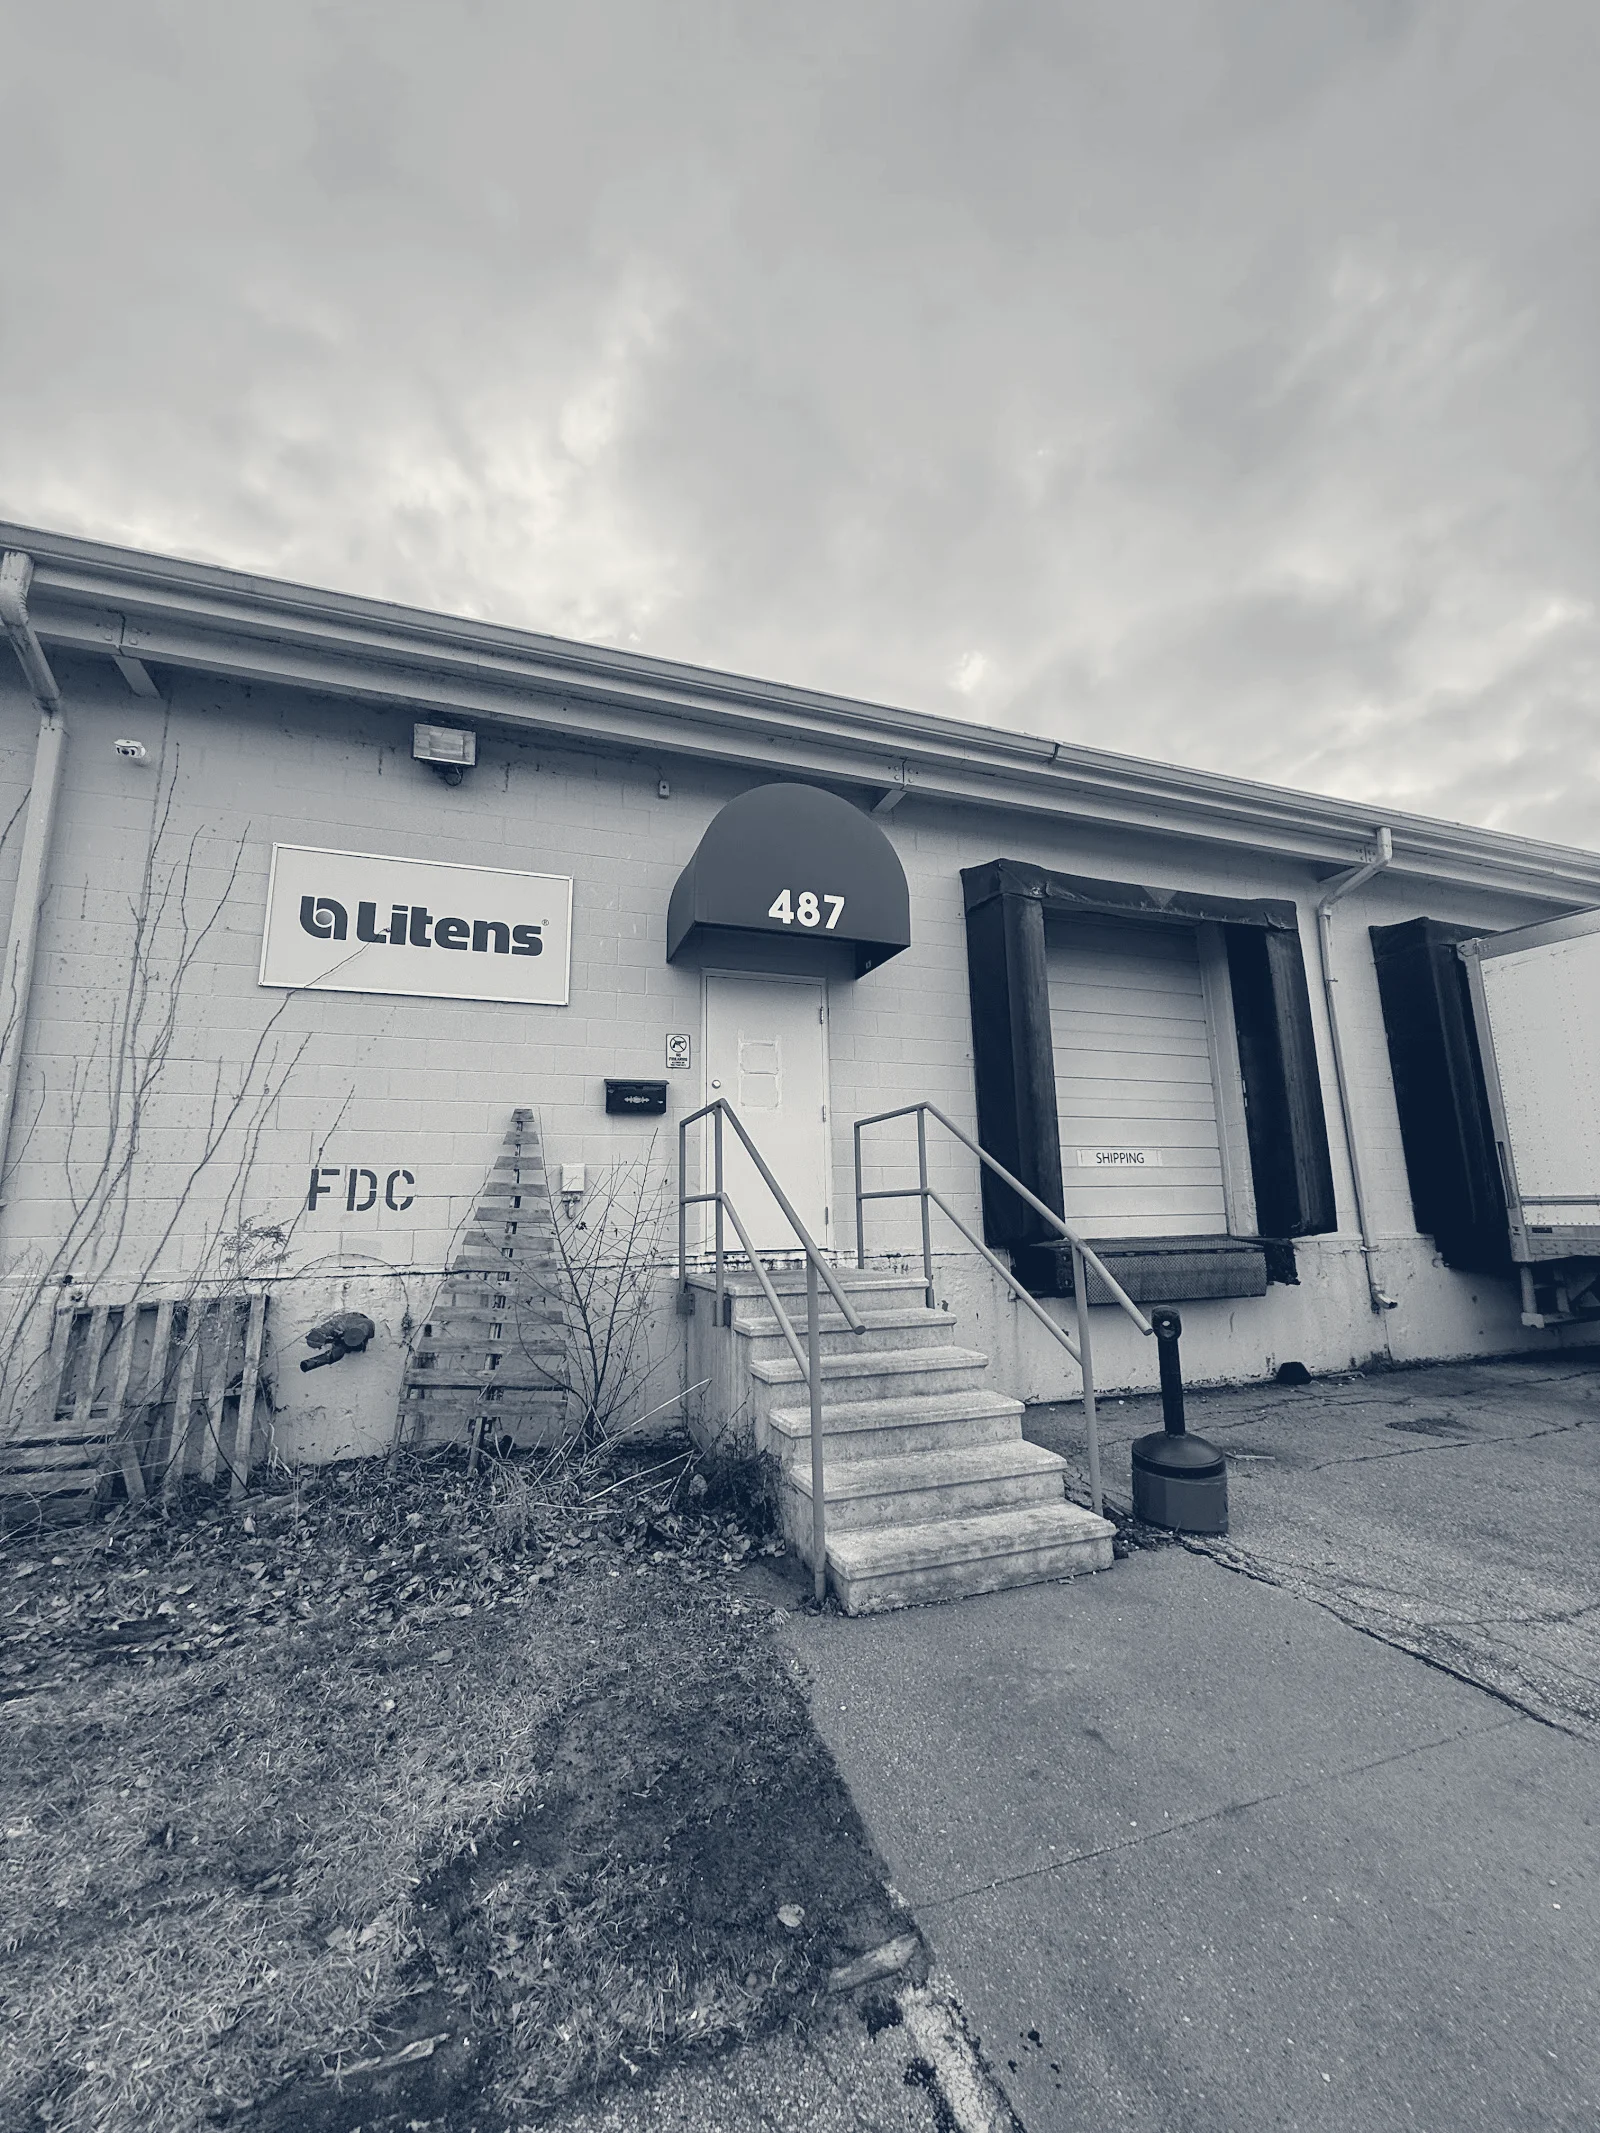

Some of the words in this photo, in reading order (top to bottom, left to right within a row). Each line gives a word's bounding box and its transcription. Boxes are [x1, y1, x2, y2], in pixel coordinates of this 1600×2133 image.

[768, 889, 845, 930] 487
[1095, 1152, 1145, 1164] SHIPPING
[307, 1168, 415, 1212] FDC
